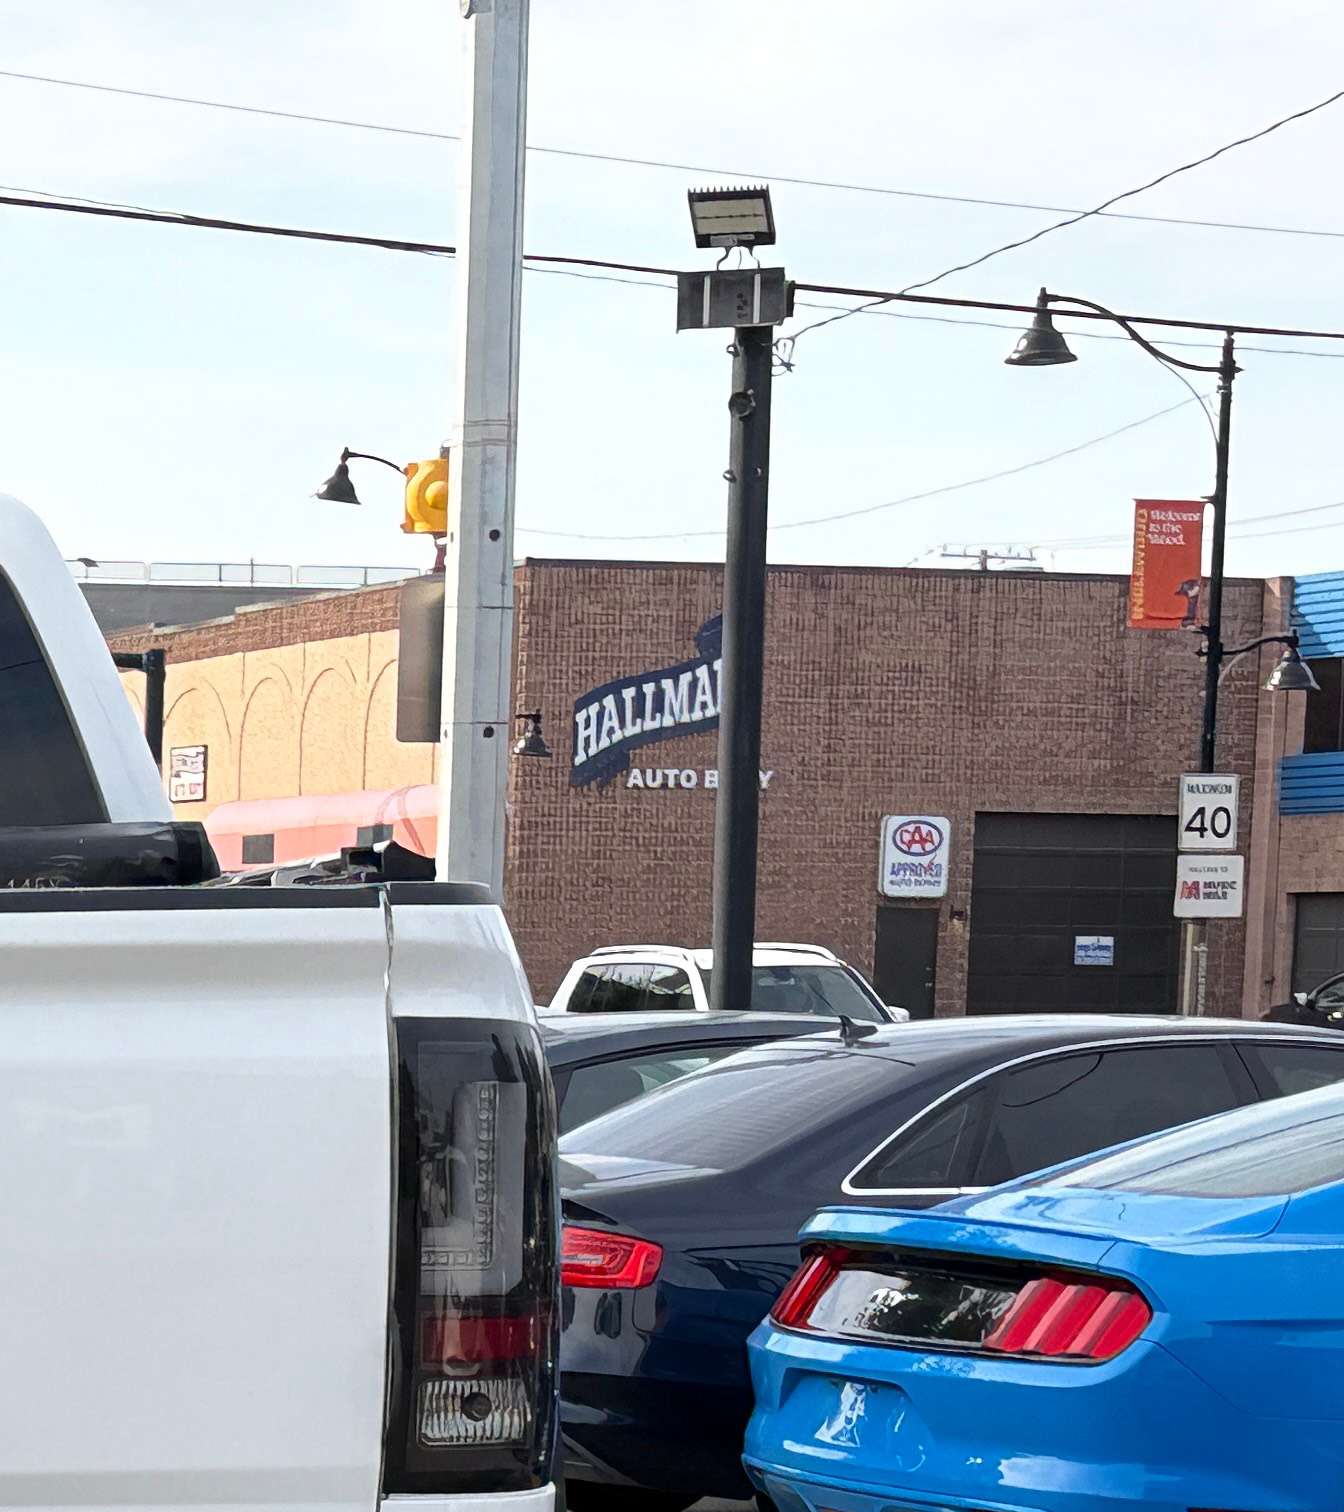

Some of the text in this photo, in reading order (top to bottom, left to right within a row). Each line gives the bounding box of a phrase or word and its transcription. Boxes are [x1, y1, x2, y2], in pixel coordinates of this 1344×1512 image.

[574, 657, 722, 767] HALLMA
[626, 767, 775, 790] AUTO BY
[1184, 805, 1232, 839] 40
[900, 825, 936, 853] CAA
